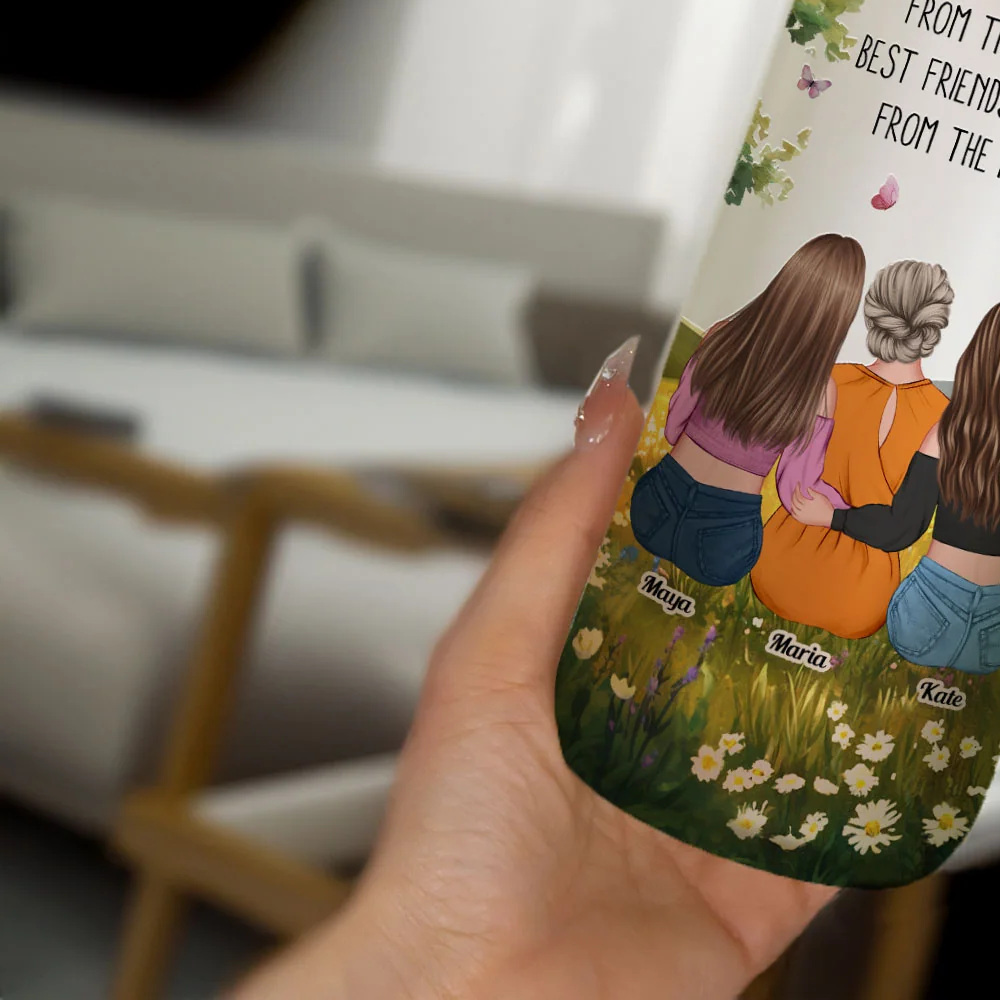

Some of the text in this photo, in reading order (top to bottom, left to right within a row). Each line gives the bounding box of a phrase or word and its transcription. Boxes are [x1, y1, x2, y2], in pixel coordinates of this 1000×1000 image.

[855, 34, 919, 84] BEST
[872, 102, 940, 154] FROM
[949, 126, 994, 173] THE
[641, 574, 692, 614] Maya
[769, 632, 827, 669] Maria
[919, 681, 964, 708] Kate
